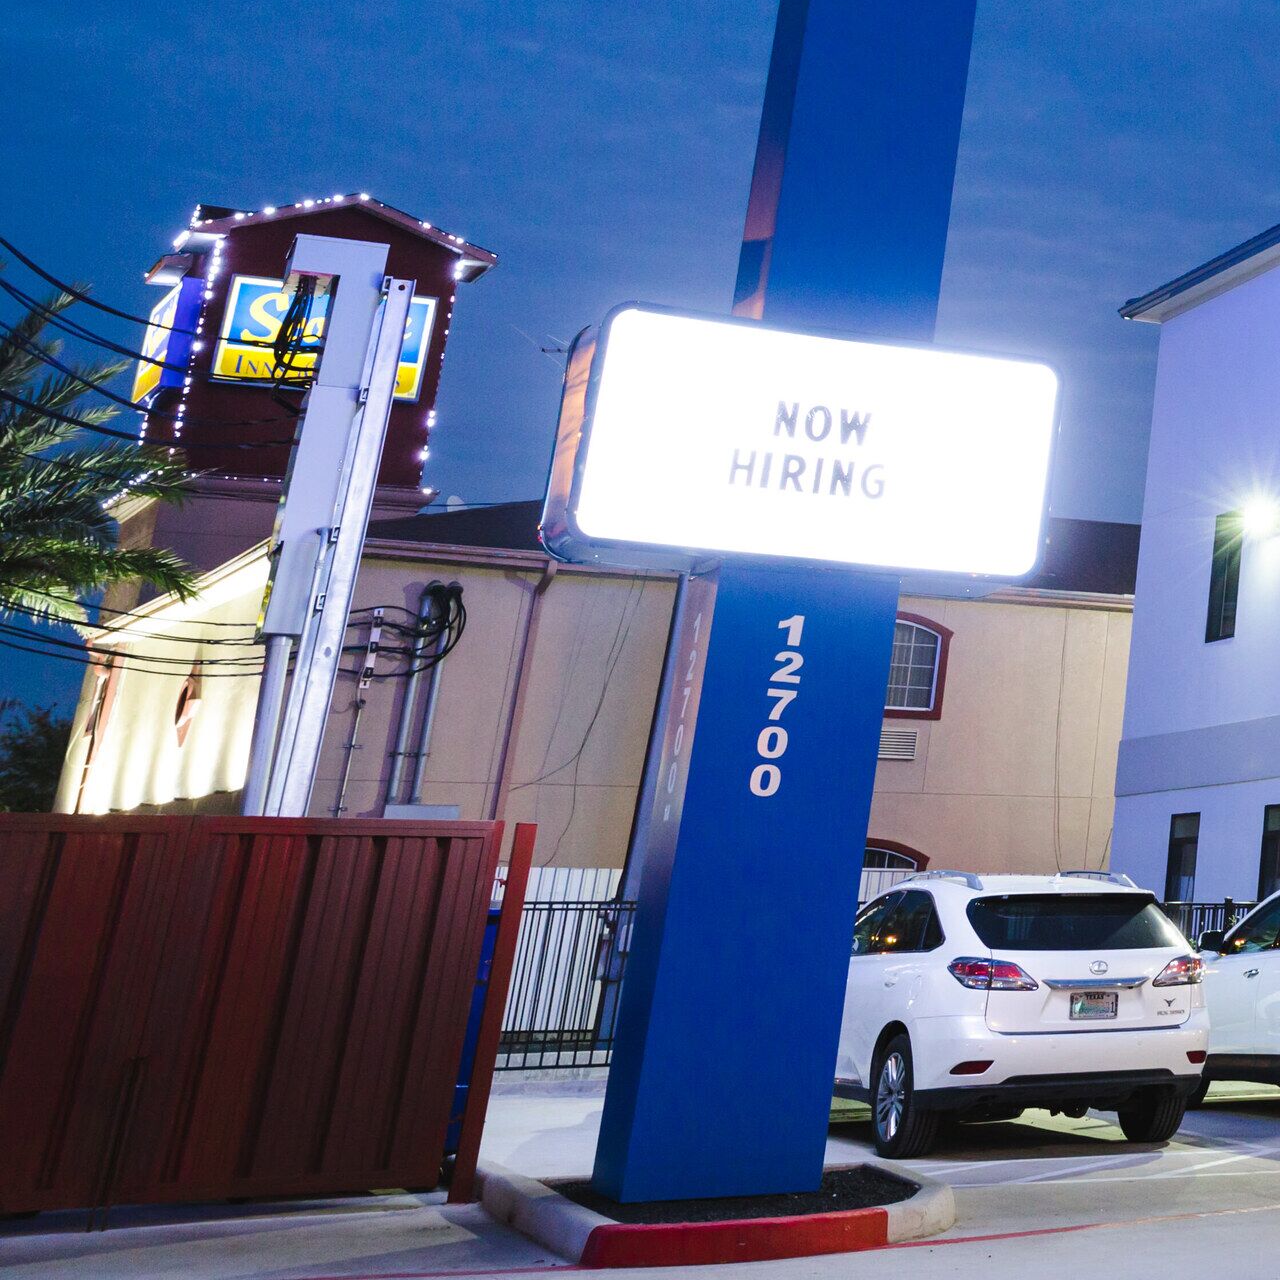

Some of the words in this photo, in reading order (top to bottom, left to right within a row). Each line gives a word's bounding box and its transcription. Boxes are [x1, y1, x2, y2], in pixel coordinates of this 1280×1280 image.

[773, 400, 872, 446] NOW
[728, 448, 886, 500] HIRING
[750, 614, 806, 798] 12700
